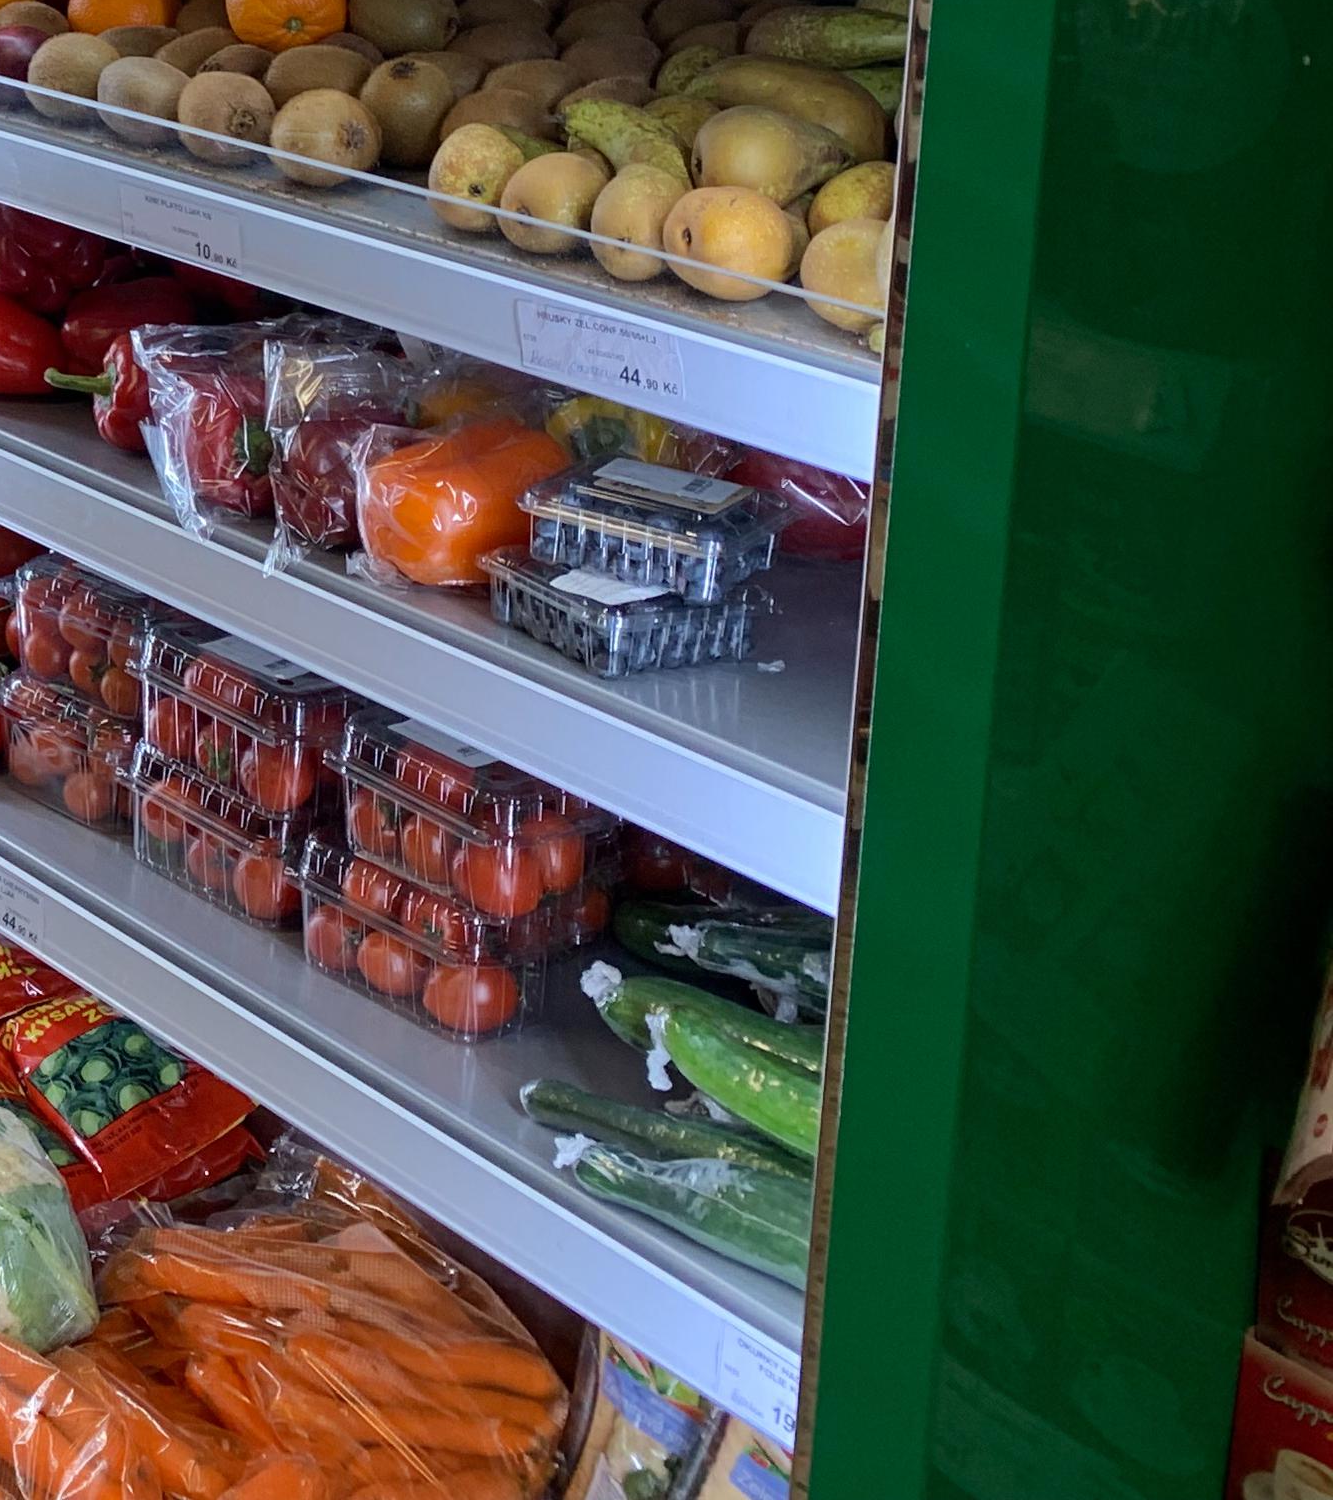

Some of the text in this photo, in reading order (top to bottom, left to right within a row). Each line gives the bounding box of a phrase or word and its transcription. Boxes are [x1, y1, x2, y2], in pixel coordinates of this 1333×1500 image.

[226, 256, 238, 268] Kč
[663, 383, 679, 396] Kč
[772, 1406, 797, 1433] 19
